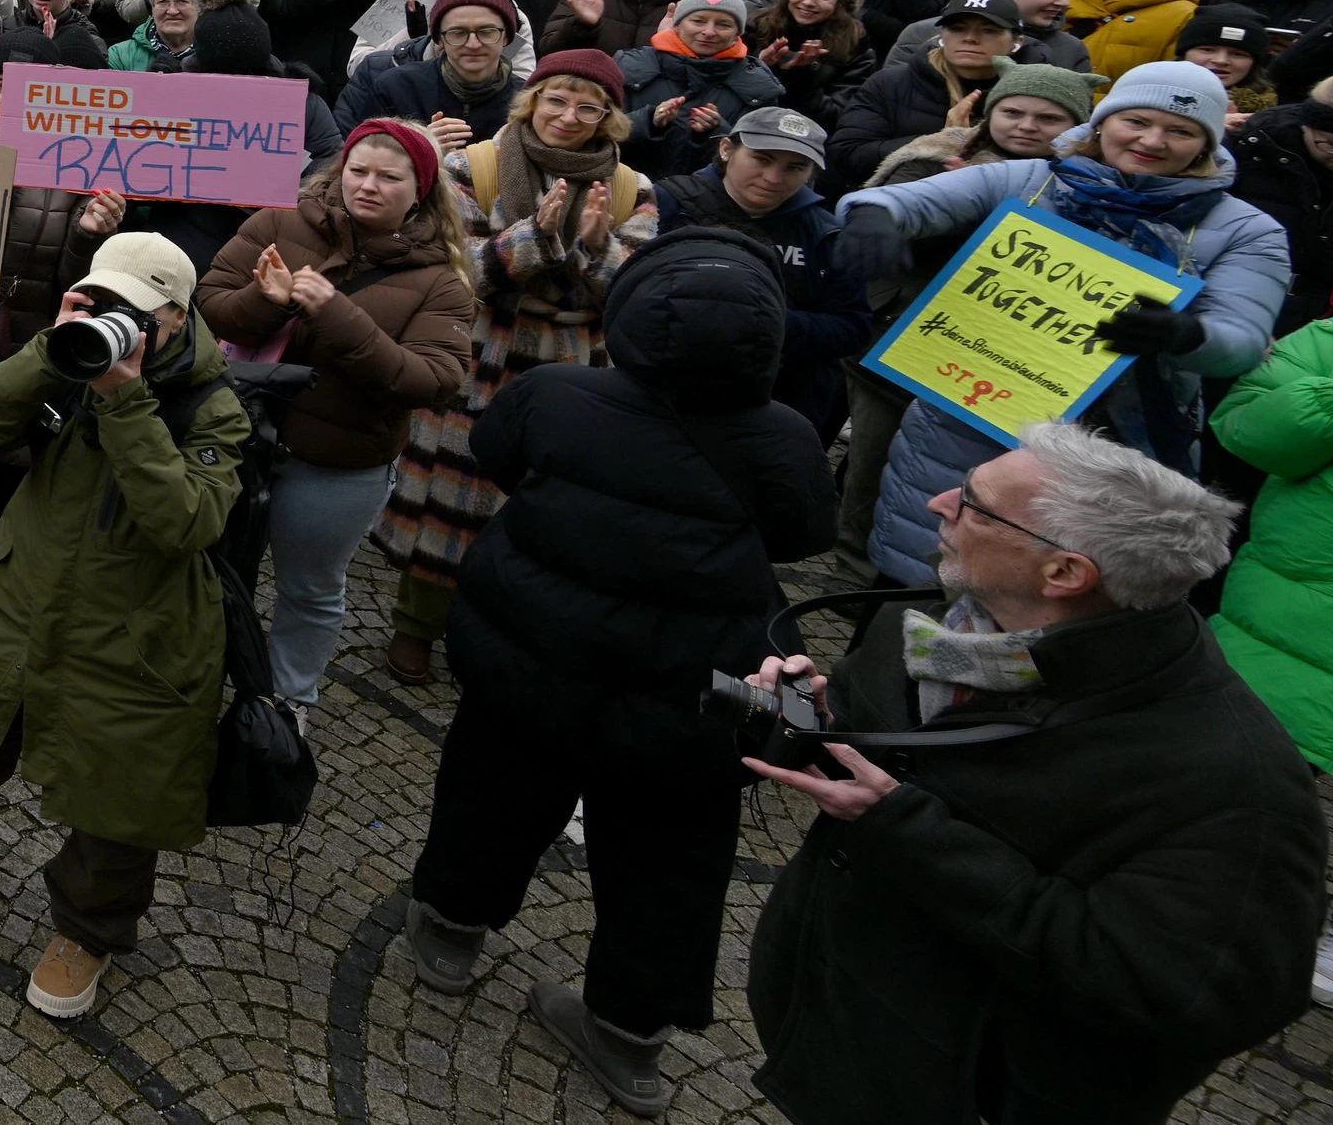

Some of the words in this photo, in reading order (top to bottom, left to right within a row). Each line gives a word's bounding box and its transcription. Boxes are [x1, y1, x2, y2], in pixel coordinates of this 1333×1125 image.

[27, 83, 129, 110] FILLED
[25, 111, 105, 138] WITH
[113, 116, 193, 144] LOVE
[192, 117, 300, 156] FEMALE
[38, 136, 233, 202] RAGE
[775, 244, 805, 266] VE
[962, 266, 1102, 355] TOGETHER
